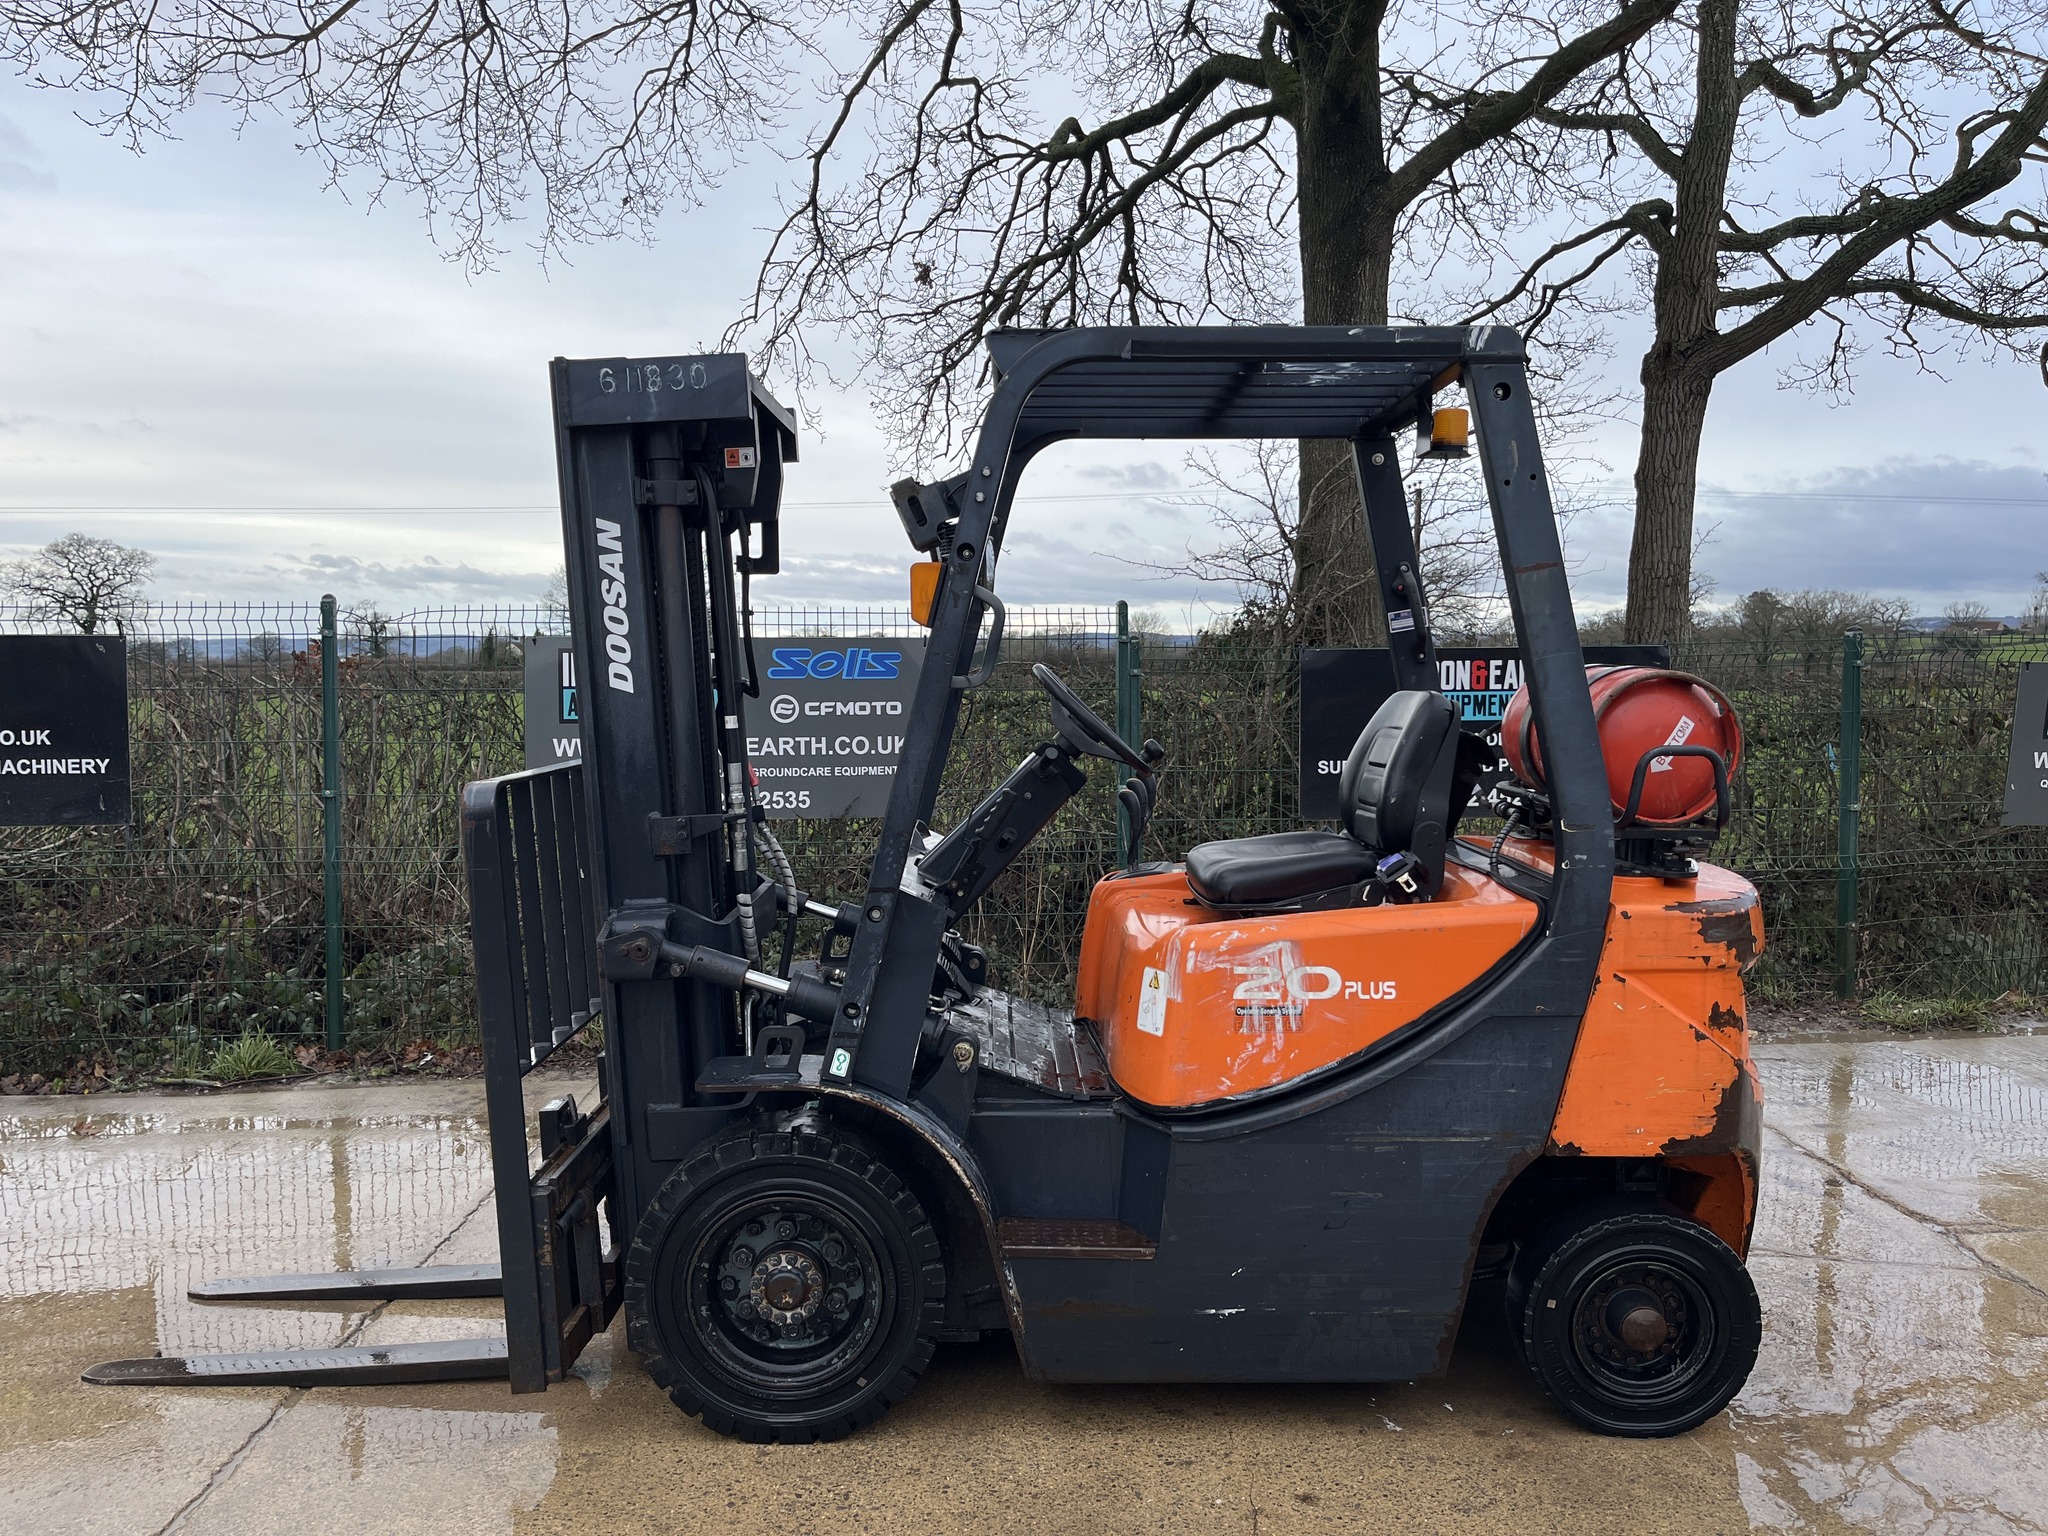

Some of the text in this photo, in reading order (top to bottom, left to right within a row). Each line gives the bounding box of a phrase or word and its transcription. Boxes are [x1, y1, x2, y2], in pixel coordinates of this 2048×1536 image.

[596, 518, 634, 693] DOOSAN
[767, 648, 902, 679] Solis
[804, 701, 902, 716] CFMOTO
[0, 730, 51, 746] O.UK
[1655, 720, 1691, 766] BTOM
[0, 758, 110, 775] ACHINERY
[753, 767, 832, 778] GROUNDCARE
[1232, 965, 1397, 1000] 20 PLUS
